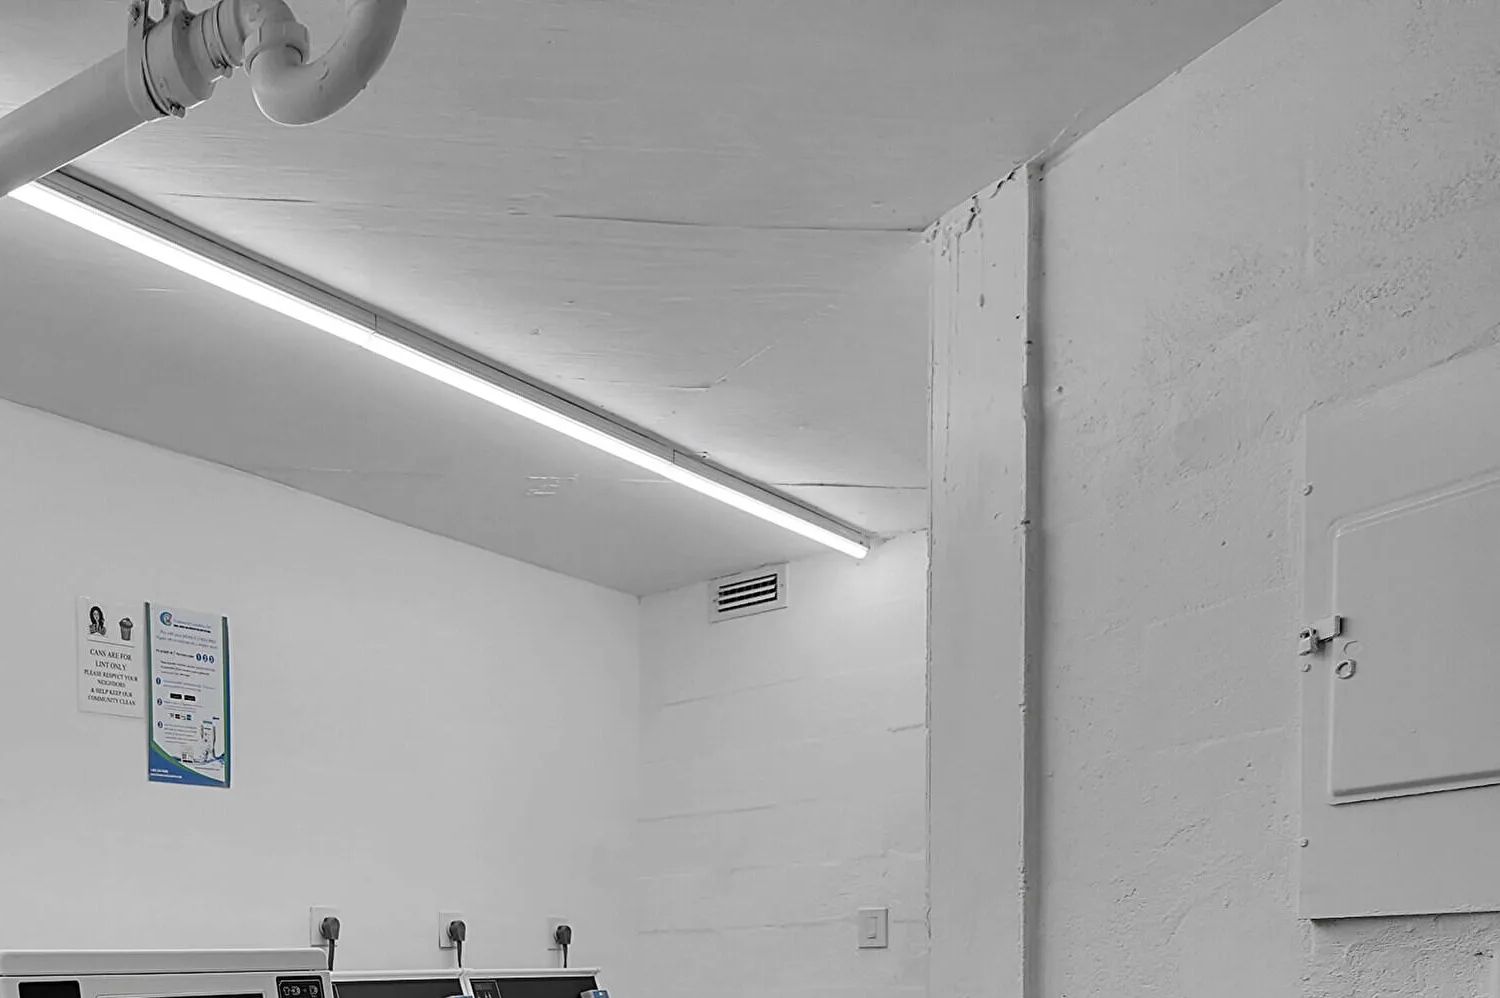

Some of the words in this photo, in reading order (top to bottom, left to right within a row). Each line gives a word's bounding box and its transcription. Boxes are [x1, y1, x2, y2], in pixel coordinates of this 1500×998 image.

[90, 649, 106, 657] CANS
[120, 653, 132, 661] FOR
[96, 660, 109, 669] LINT
[110, 663, 127, 671] ONLY
[84, 669, 101, 677] PLEASE
[103, 672, 123, 680] RESPECT
[88, 695, 119, 703] COMMUNITY
